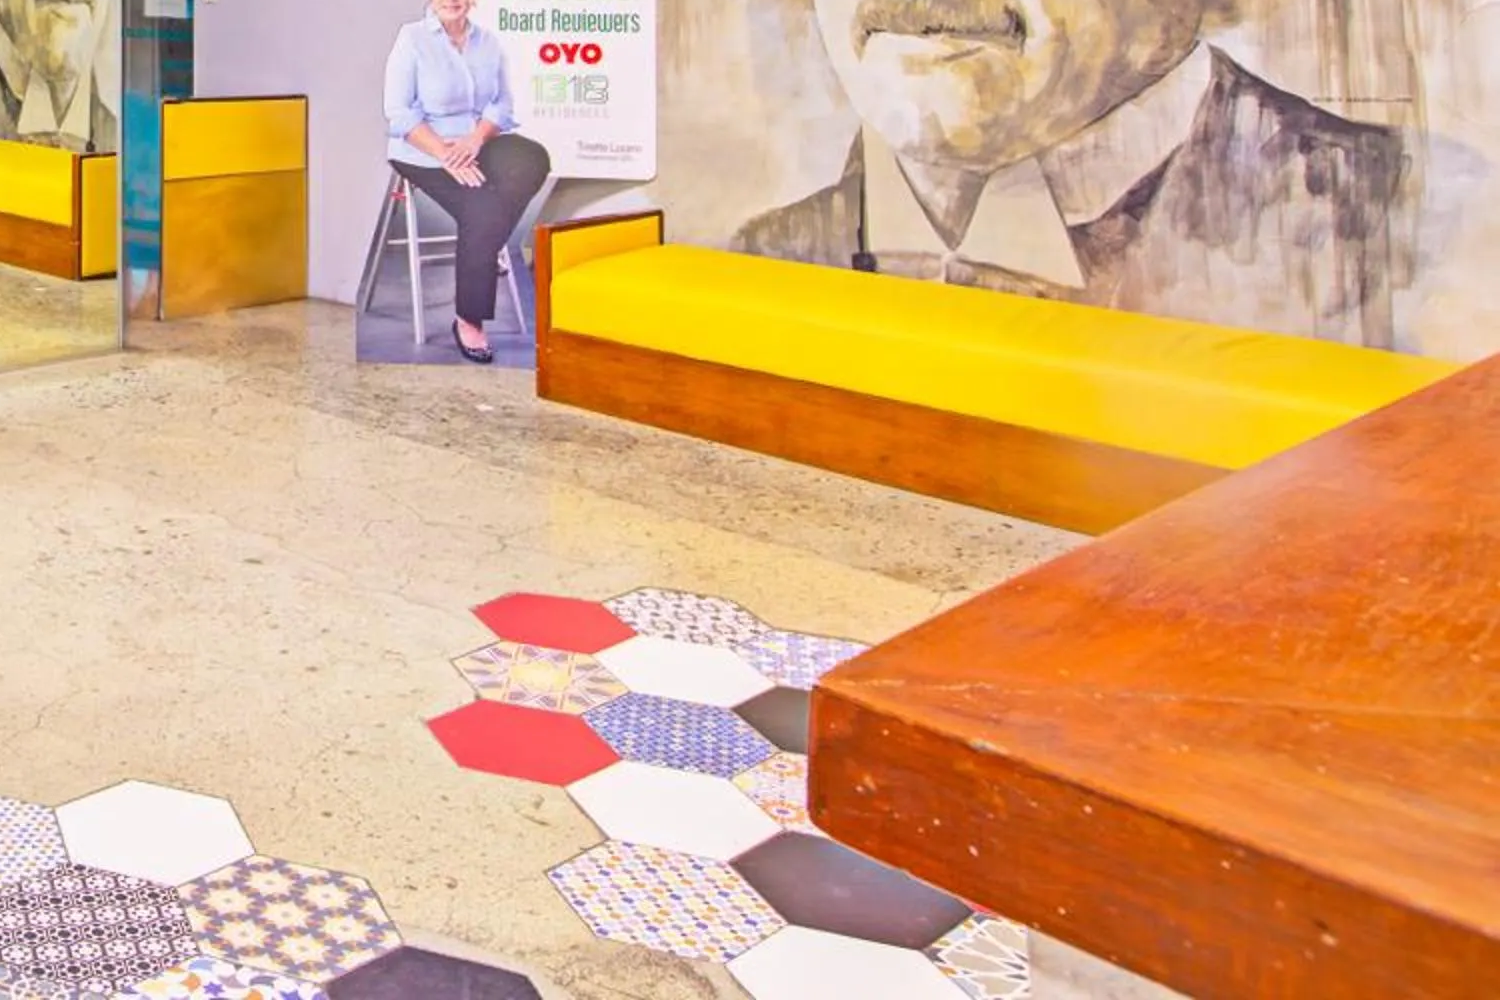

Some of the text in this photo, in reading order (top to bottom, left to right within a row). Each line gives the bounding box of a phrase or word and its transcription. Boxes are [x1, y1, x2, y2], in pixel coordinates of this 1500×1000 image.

[499, 7, 641, 33] Board Reviewers
[539, 43, 603, 65] OYO
[531, 75, 609, 104] 1318
